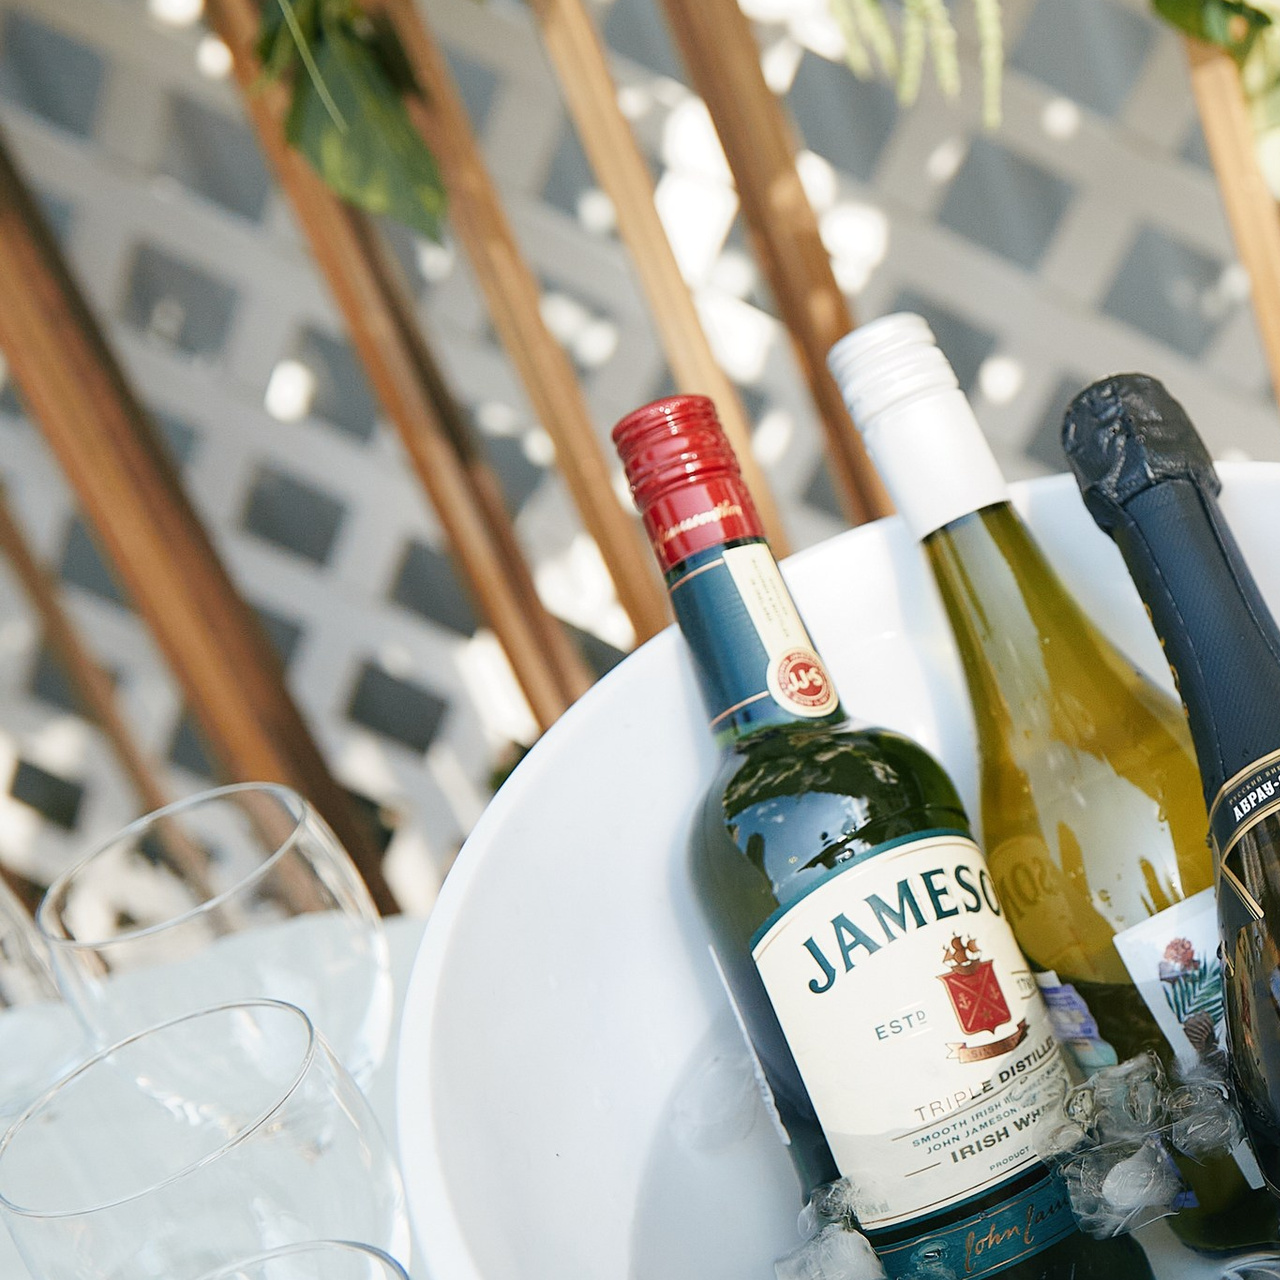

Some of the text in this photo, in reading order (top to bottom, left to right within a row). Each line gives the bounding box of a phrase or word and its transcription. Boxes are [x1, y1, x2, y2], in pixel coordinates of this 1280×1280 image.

[914, 1079, 994, 1121] TRIPLE
[912, 1102, 1002, 1148] SMOOTH IRISH
[927, 1107, 1018, 1155] JOHN JAMESON
[951, 1125, 1010, 1164] IRISH
[989, 1145, 1030, 1171] PRODUCT
[964, 1222, 1021, 1273] John
